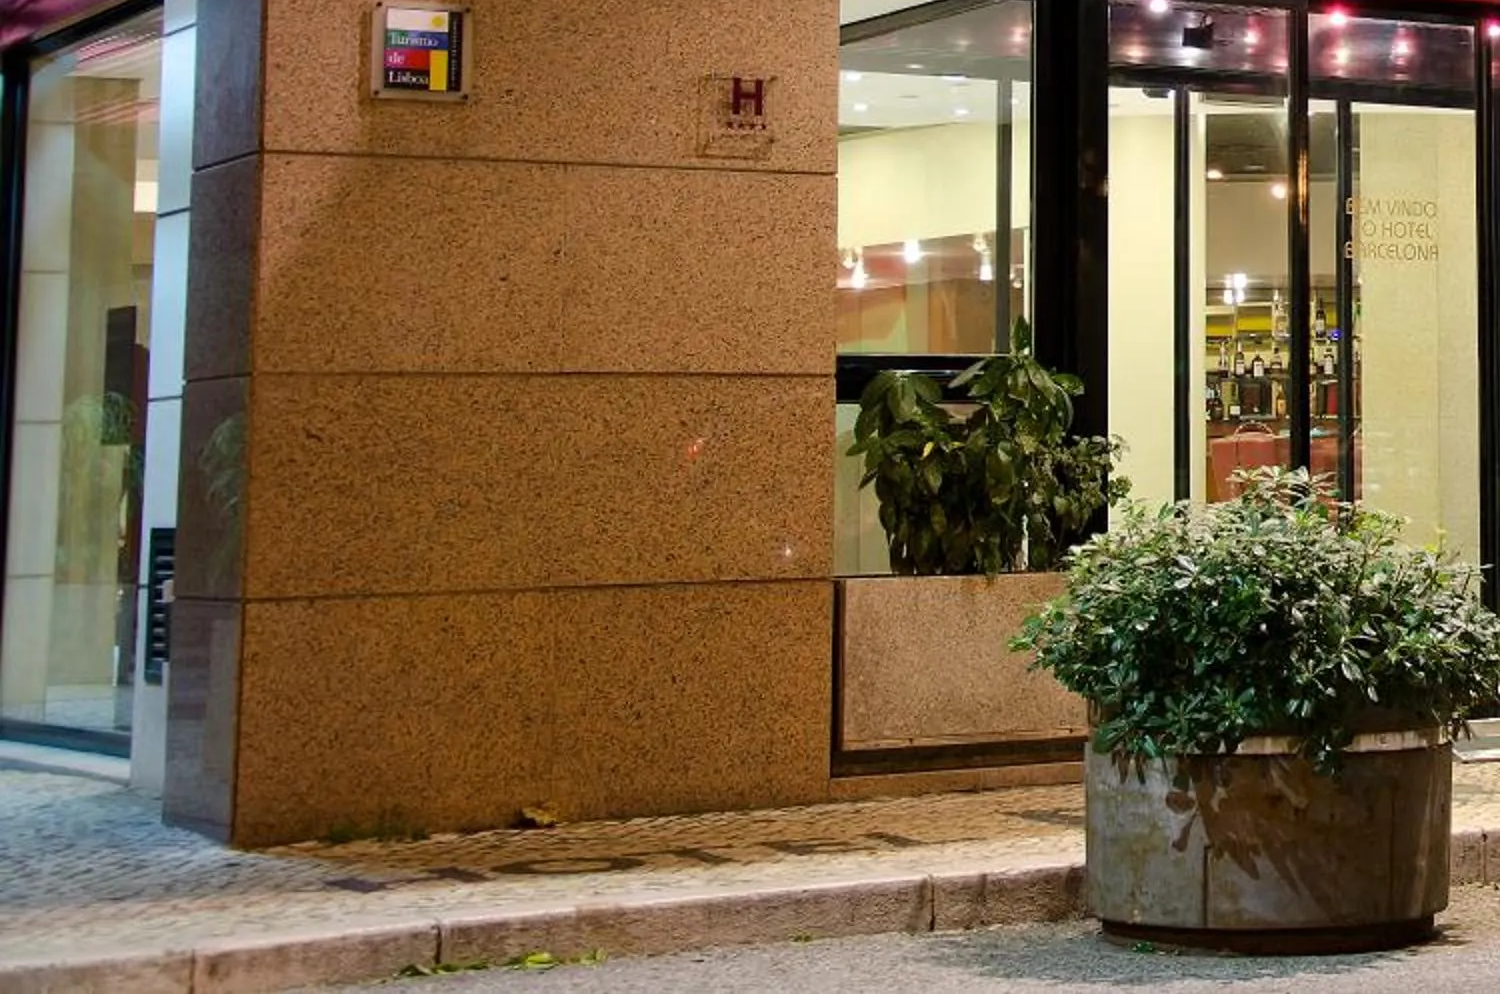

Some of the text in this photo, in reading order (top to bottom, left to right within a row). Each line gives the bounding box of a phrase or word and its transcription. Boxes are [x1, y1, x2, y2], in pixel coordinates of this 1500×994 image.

[389, 31, 440, 47] Turismo
[387, 52, 405, 65] de
[389, 70, 429, 86] Lisboa
[731, 77, 764, 117] H
[1381, 221, 1431, 239] HOTEL
[1344, 240, 1440, 261] BARCELONA
